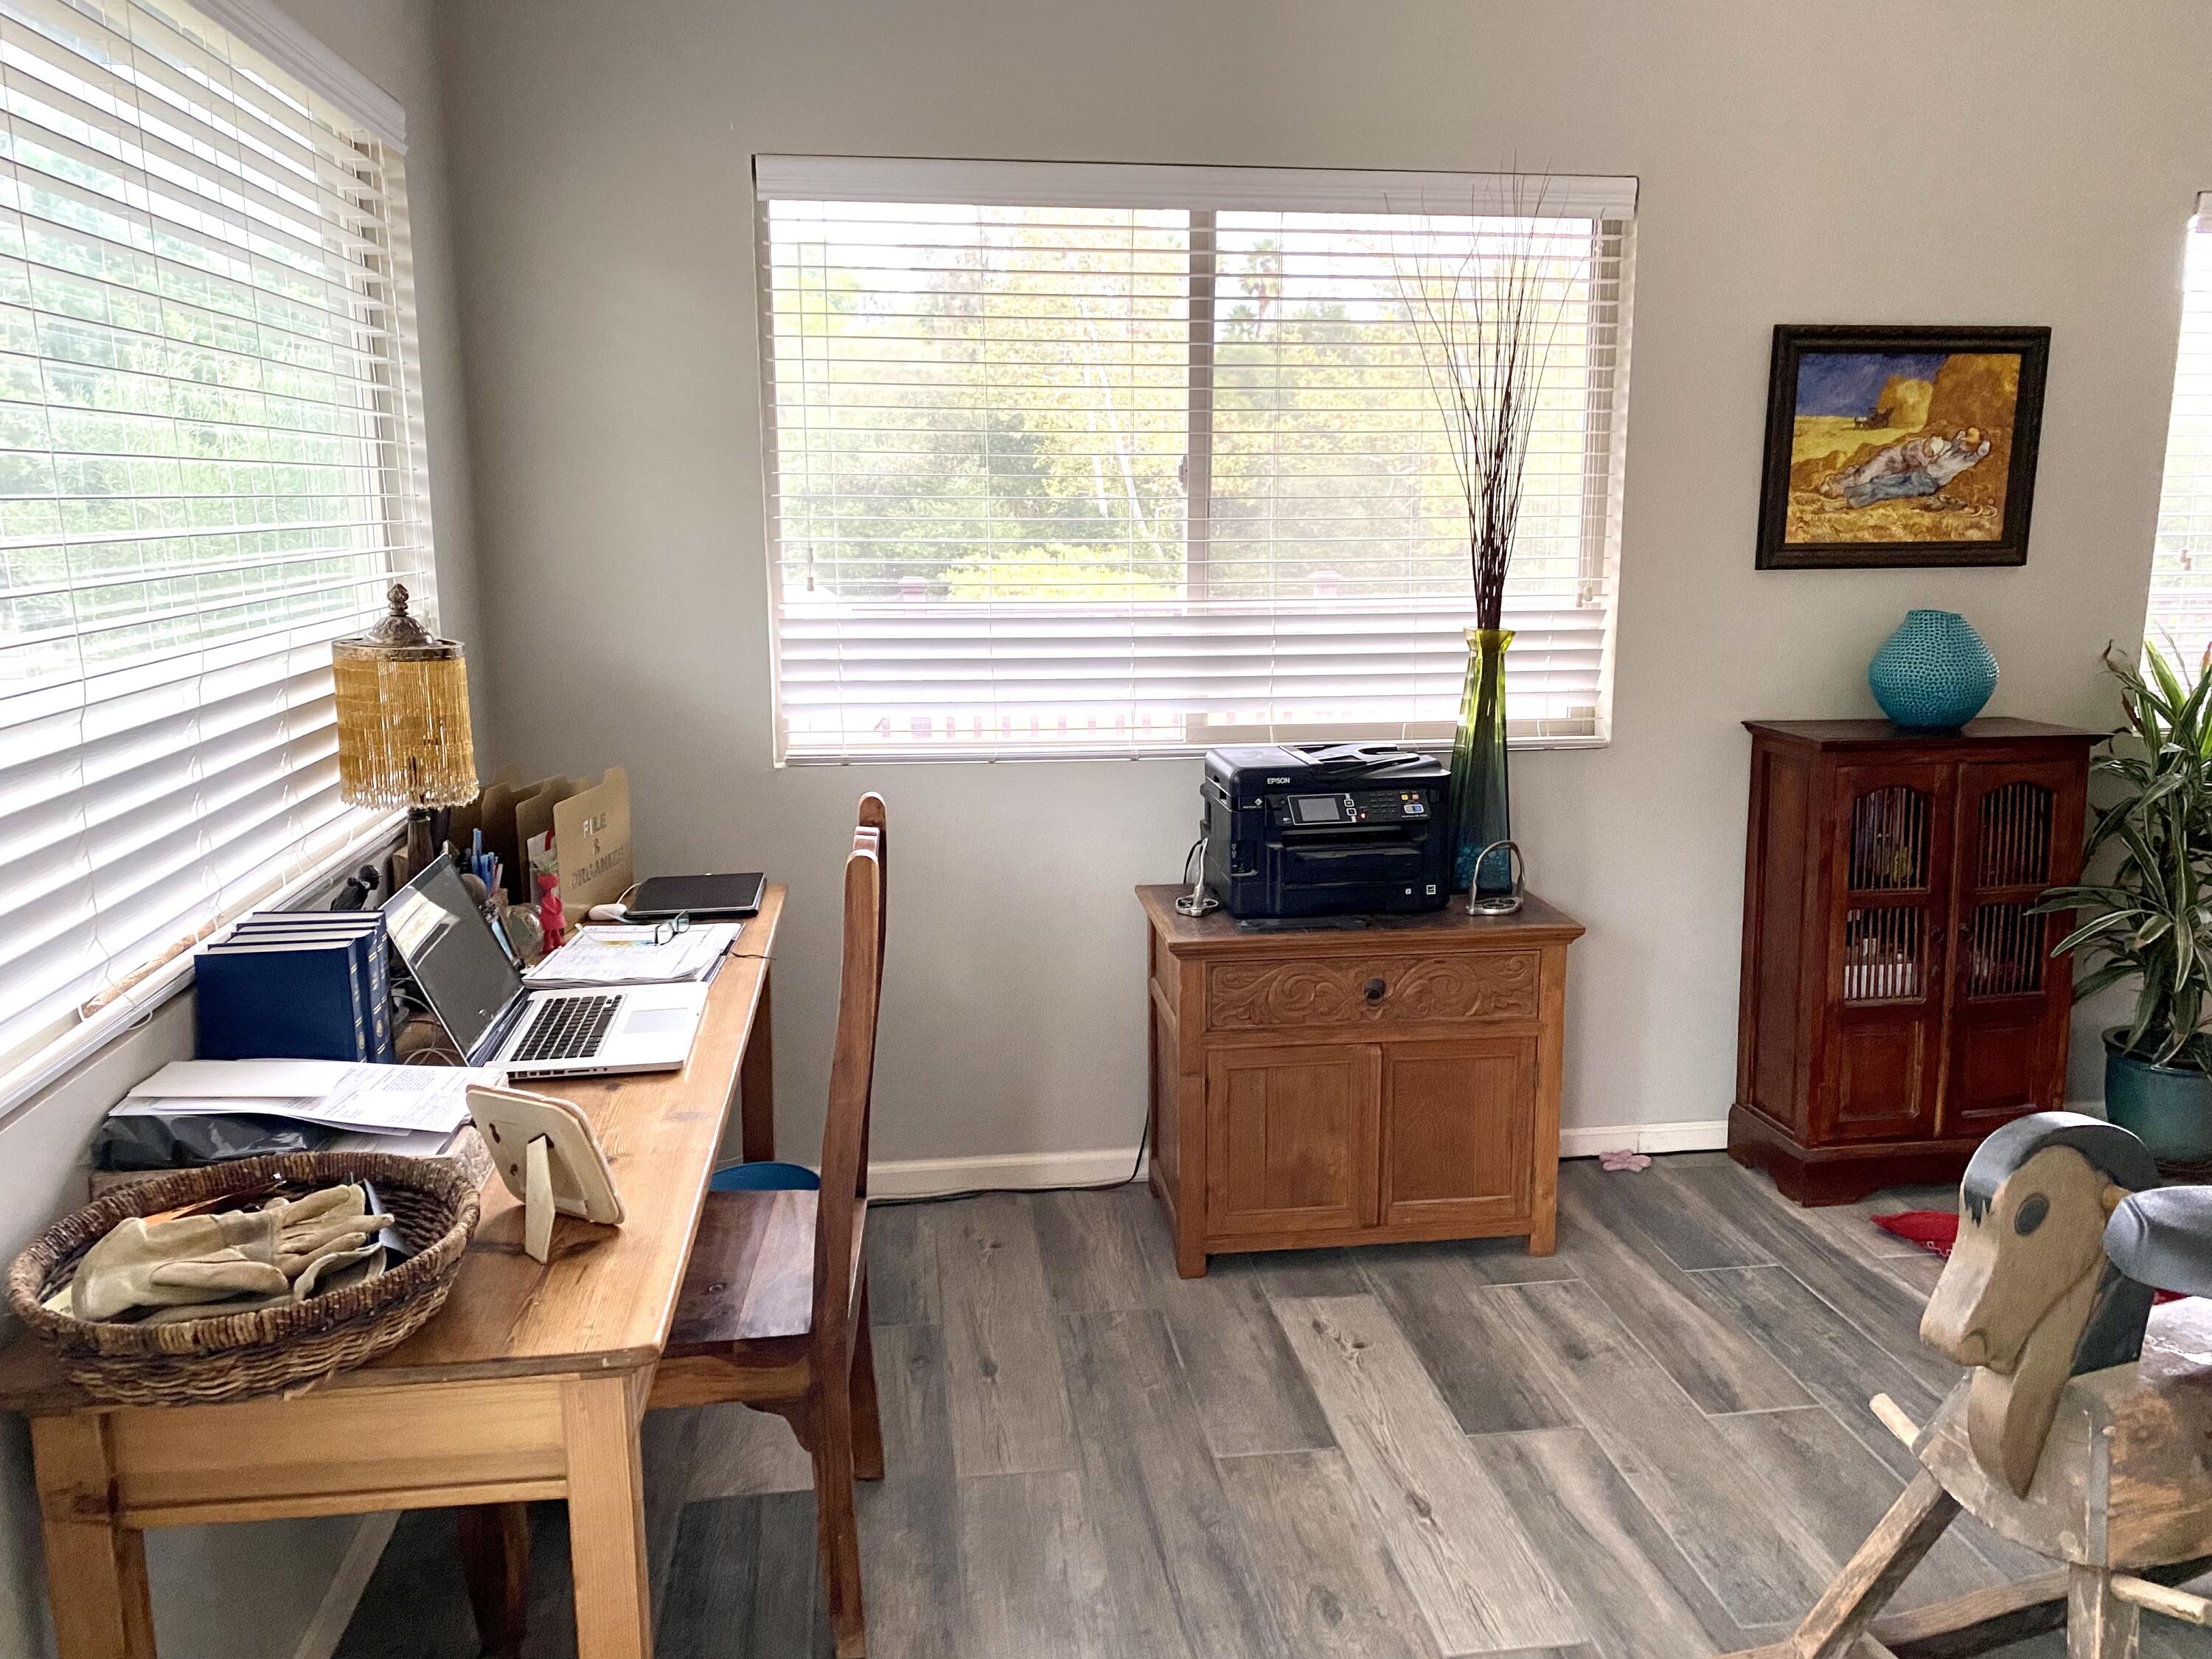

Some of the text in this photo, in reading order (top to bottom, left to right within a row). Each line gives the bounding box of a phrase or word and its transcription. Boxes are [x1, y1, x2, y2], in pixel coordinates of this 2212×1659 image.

[1267, 776, 1290, 785] EPSON
[582, 812, 607, 838] FILE
[571, 846, 625, 889] ORGANIZE
